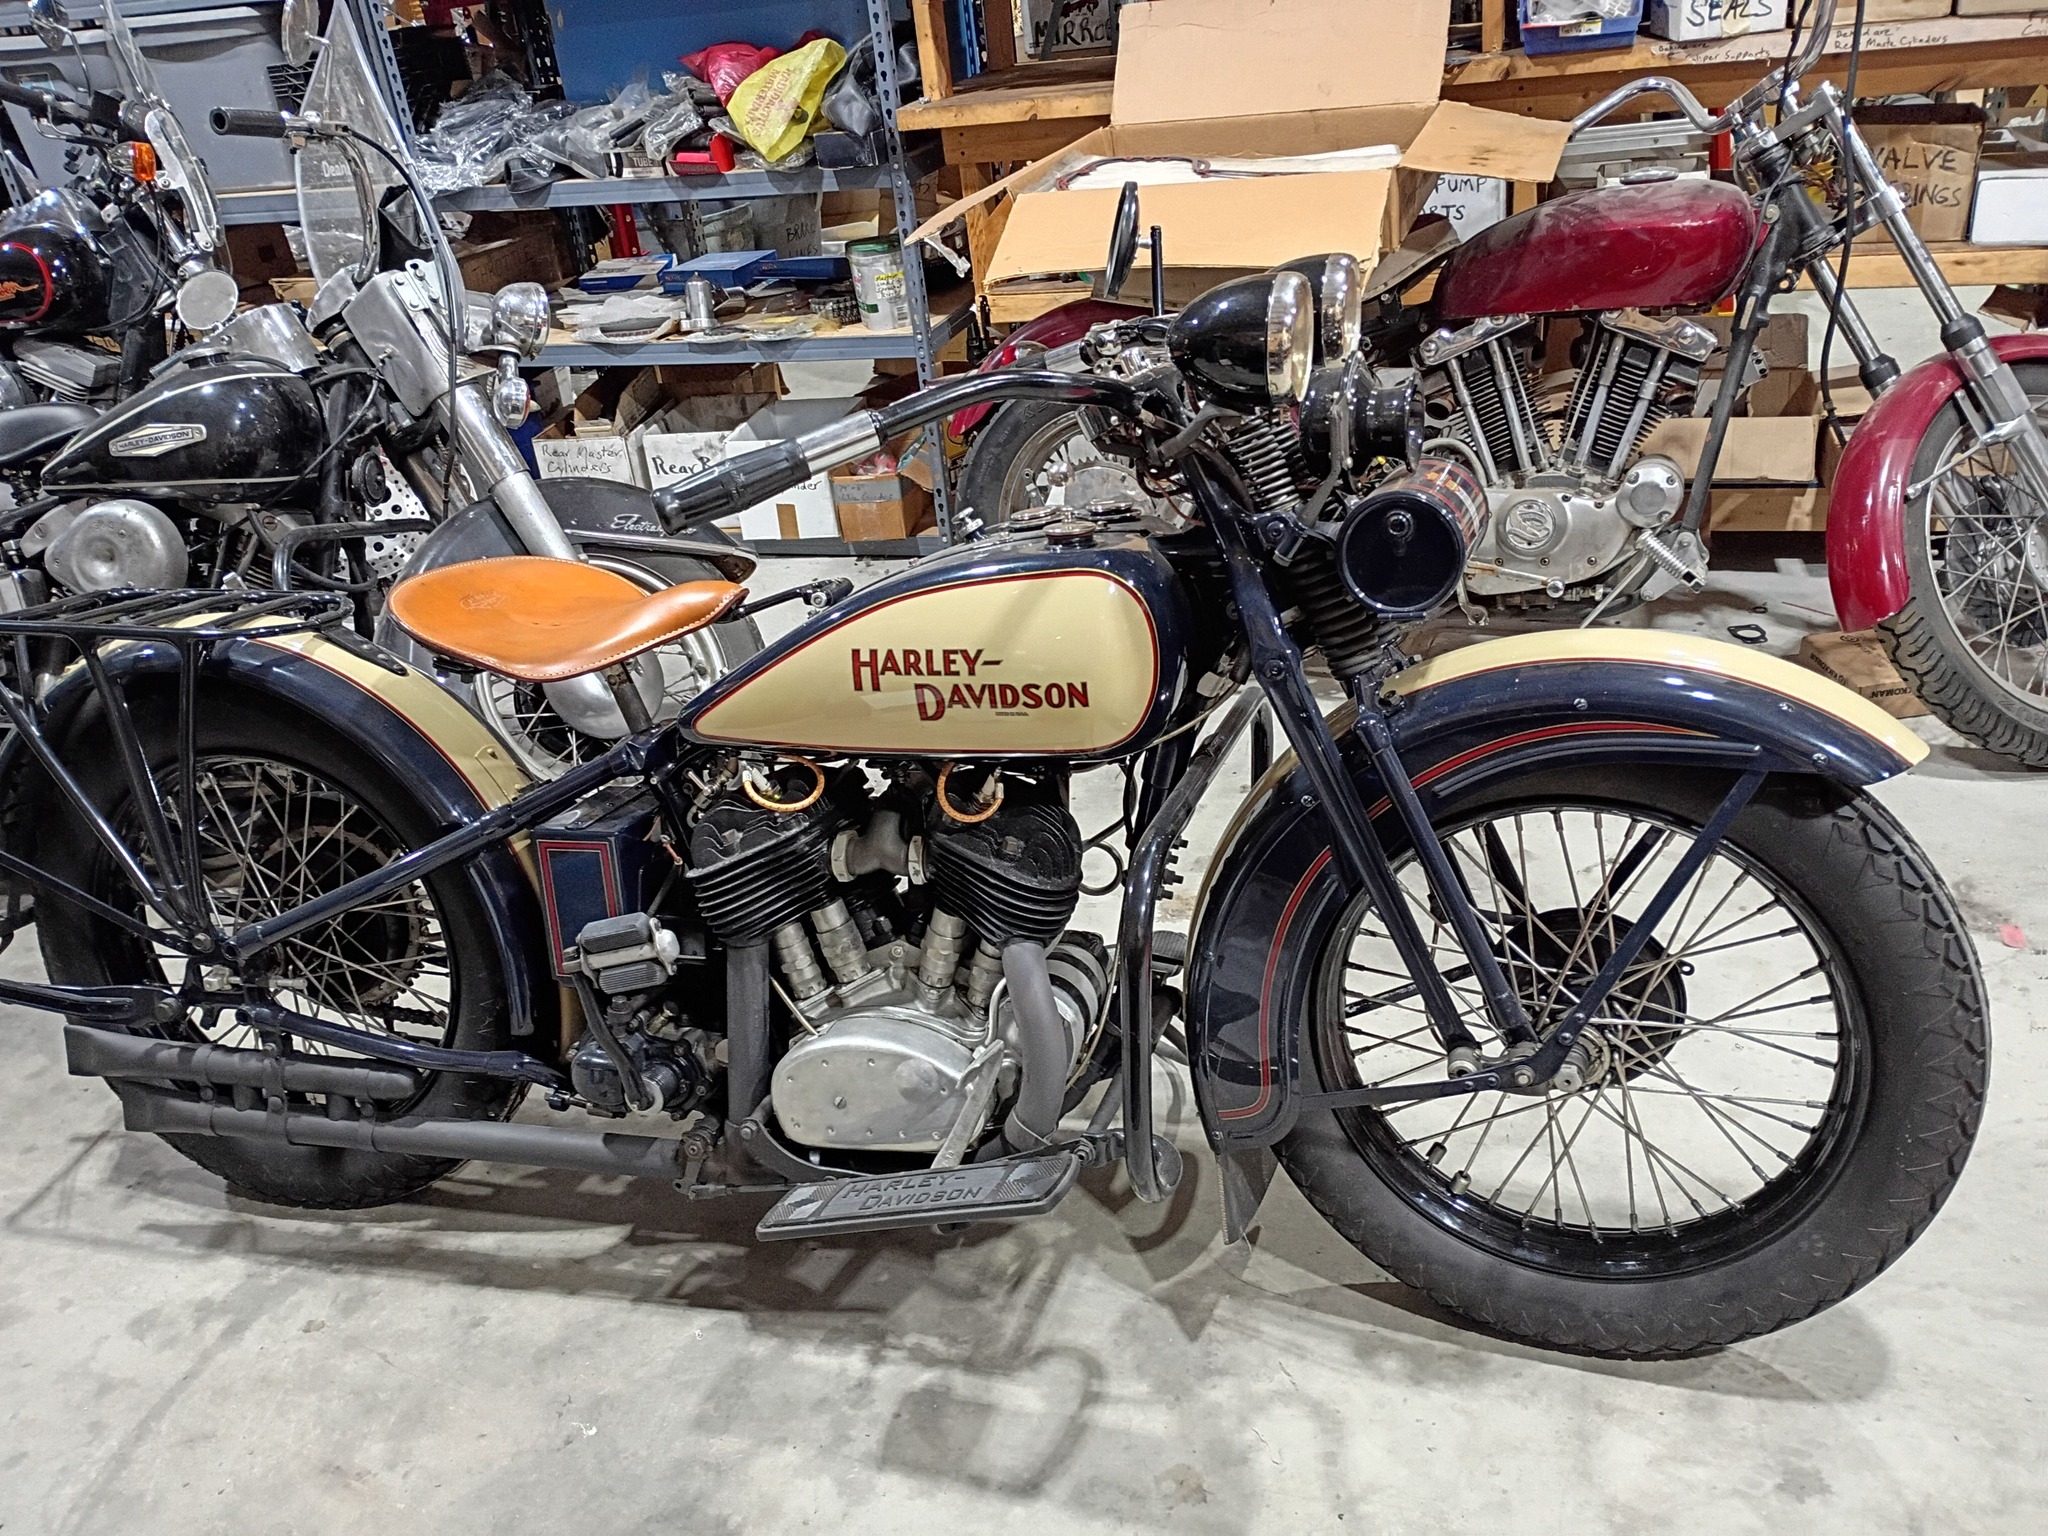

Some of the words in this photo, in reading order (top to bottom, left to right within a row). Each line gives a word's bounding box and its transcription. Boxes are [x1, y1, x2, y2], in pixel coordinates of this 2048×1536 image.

[1686, 0, 1772, 26] SEALS
[1035, 17, 1113, 47] MRRO
[1871, 147, 1957, 170] VALVE
[1435, 177, 1487, 193] PUMP
[541, 444, 570, 457] Rear
[576, 444, 624, 460] Master
[547, 460, 612, 476] Cylinders
[652, 455, 697, 475] Rear
[851, 648, 1004, 691] HARLEY-
[914, 682, 1090, 721] DAVIDSON
[858, 1186, 983, 1211] DAVIDSON
